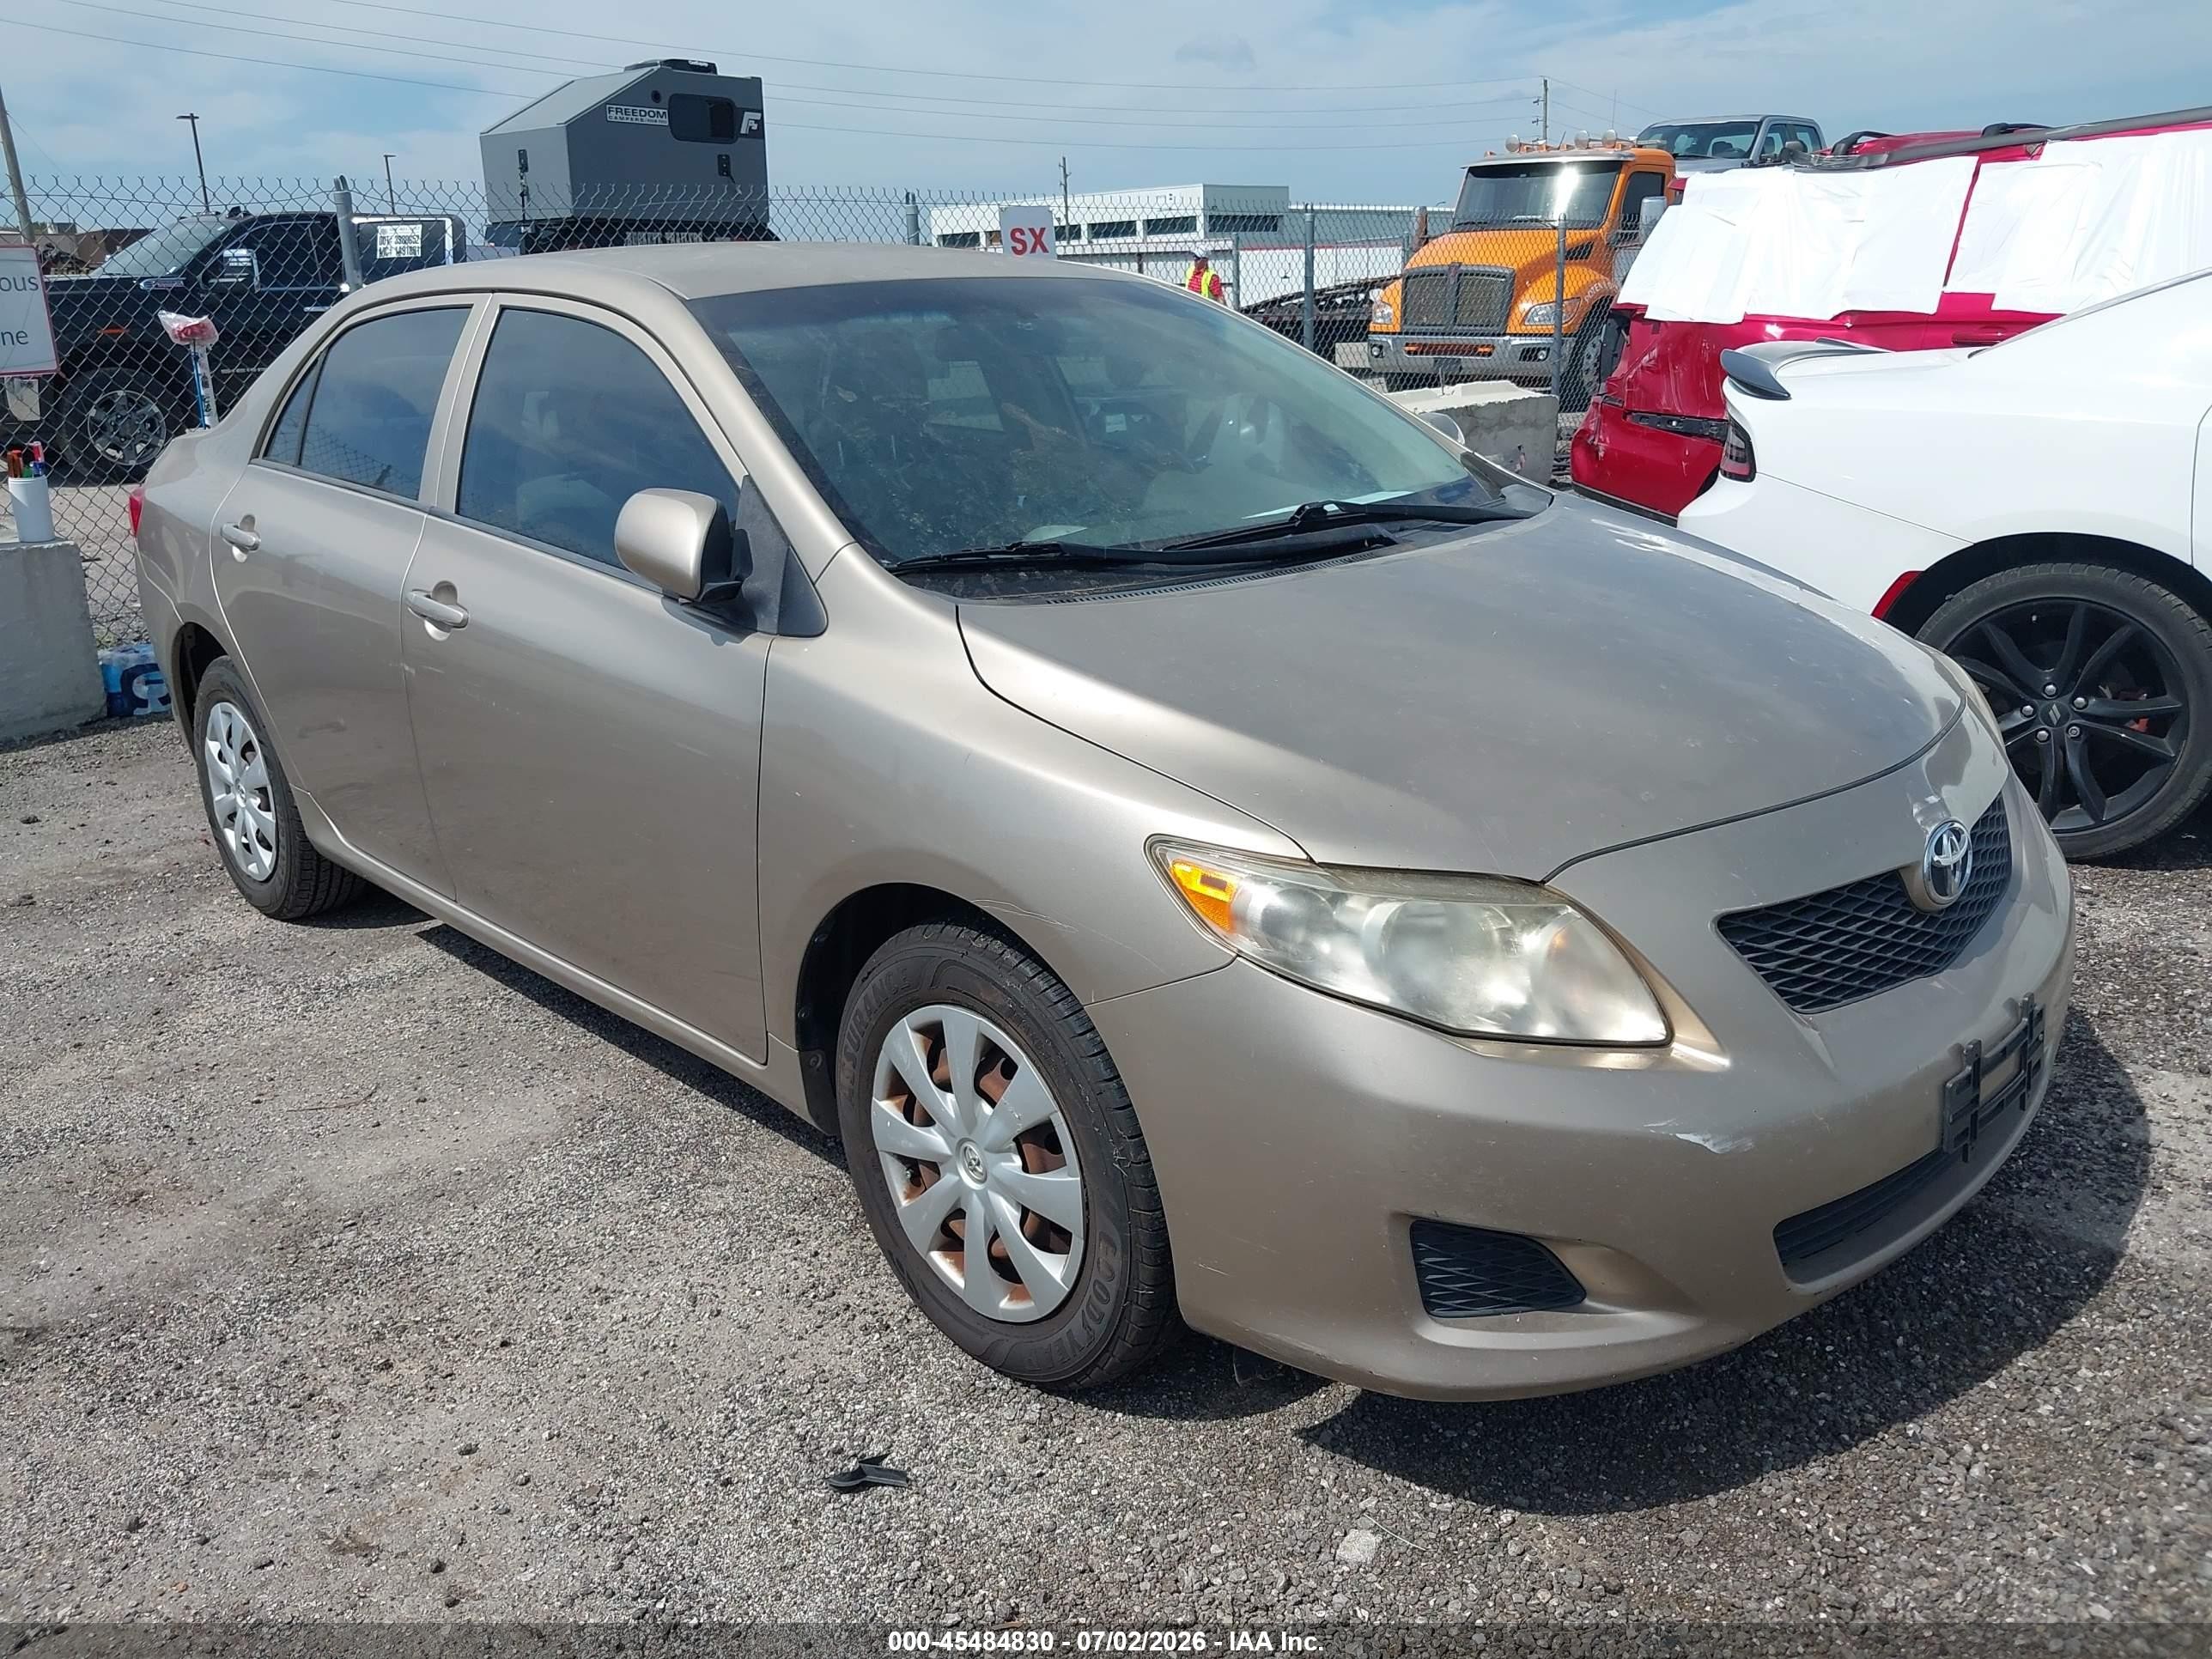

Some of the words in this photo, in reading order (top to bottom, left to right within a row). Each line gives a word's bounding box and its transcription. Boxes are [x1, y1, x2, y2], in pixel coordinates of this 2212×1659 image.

[608, 106, 667, 119] FREEDOM
[1010, 227, 1049, 256] SX
[1, 330, 29, 345] ne
